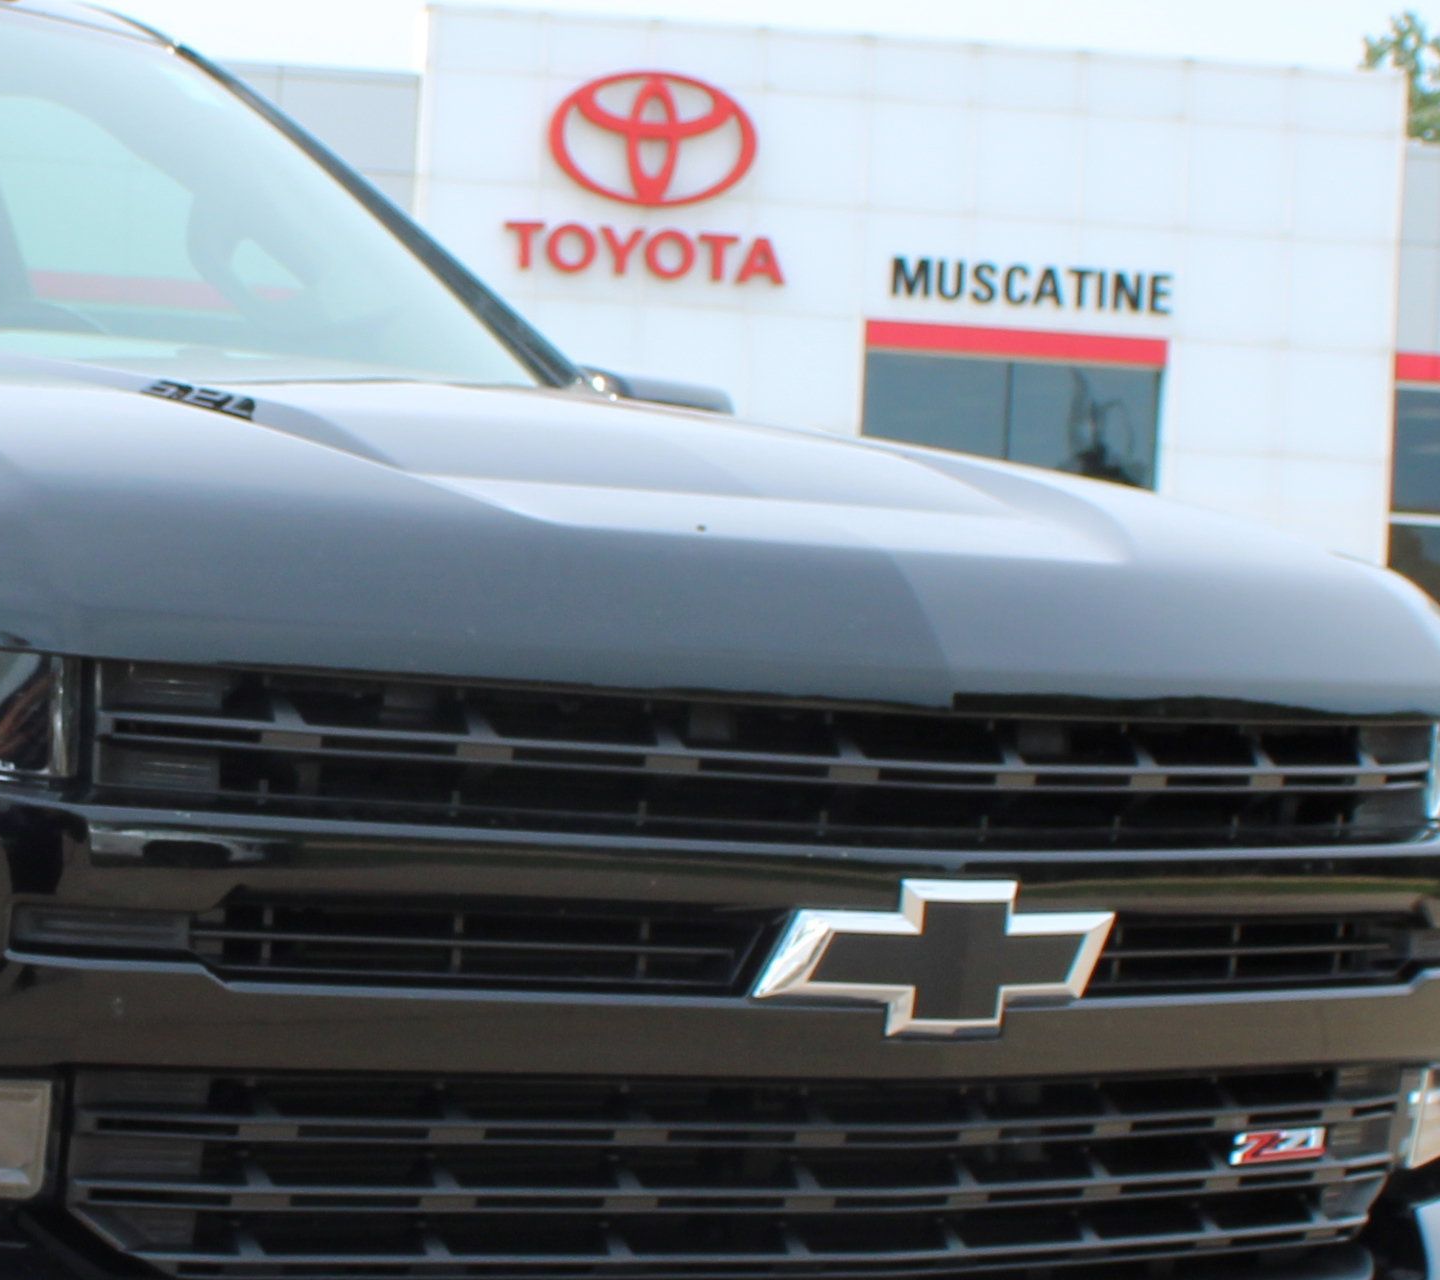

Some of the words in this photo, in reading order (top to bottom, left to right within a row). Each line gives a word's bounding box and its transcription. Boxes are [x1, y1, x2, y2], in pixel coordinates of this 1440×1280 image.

[504, 221, 786, 287] TOYOTA
[889, 256, 1173, 316] MUSCATINE
[1228, 1126, 1327, 1166] Z71
